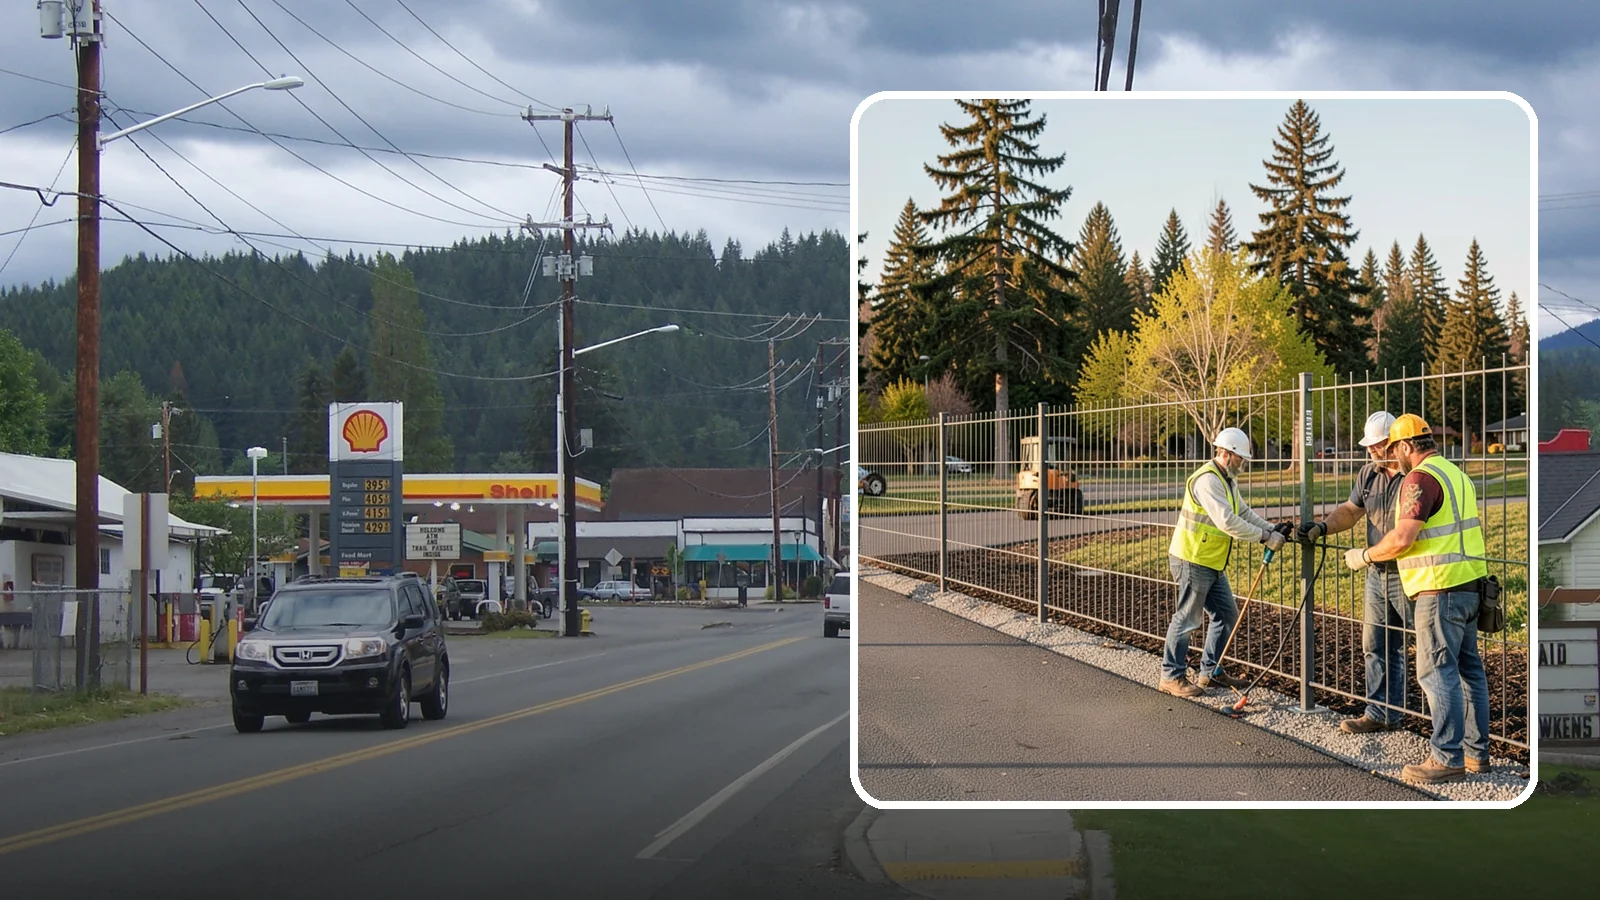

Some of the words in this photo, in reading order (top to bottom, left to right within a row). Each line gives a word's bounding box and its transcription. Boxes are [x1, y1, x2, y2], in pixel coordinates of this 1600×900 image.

[366, 480, 383, 490] 395
[490, 484, 547, 499] Shell
[366, 494, 383, 504] 405
[366, 508, 383, 518] 415
[366, 522, 383, 532] 429
